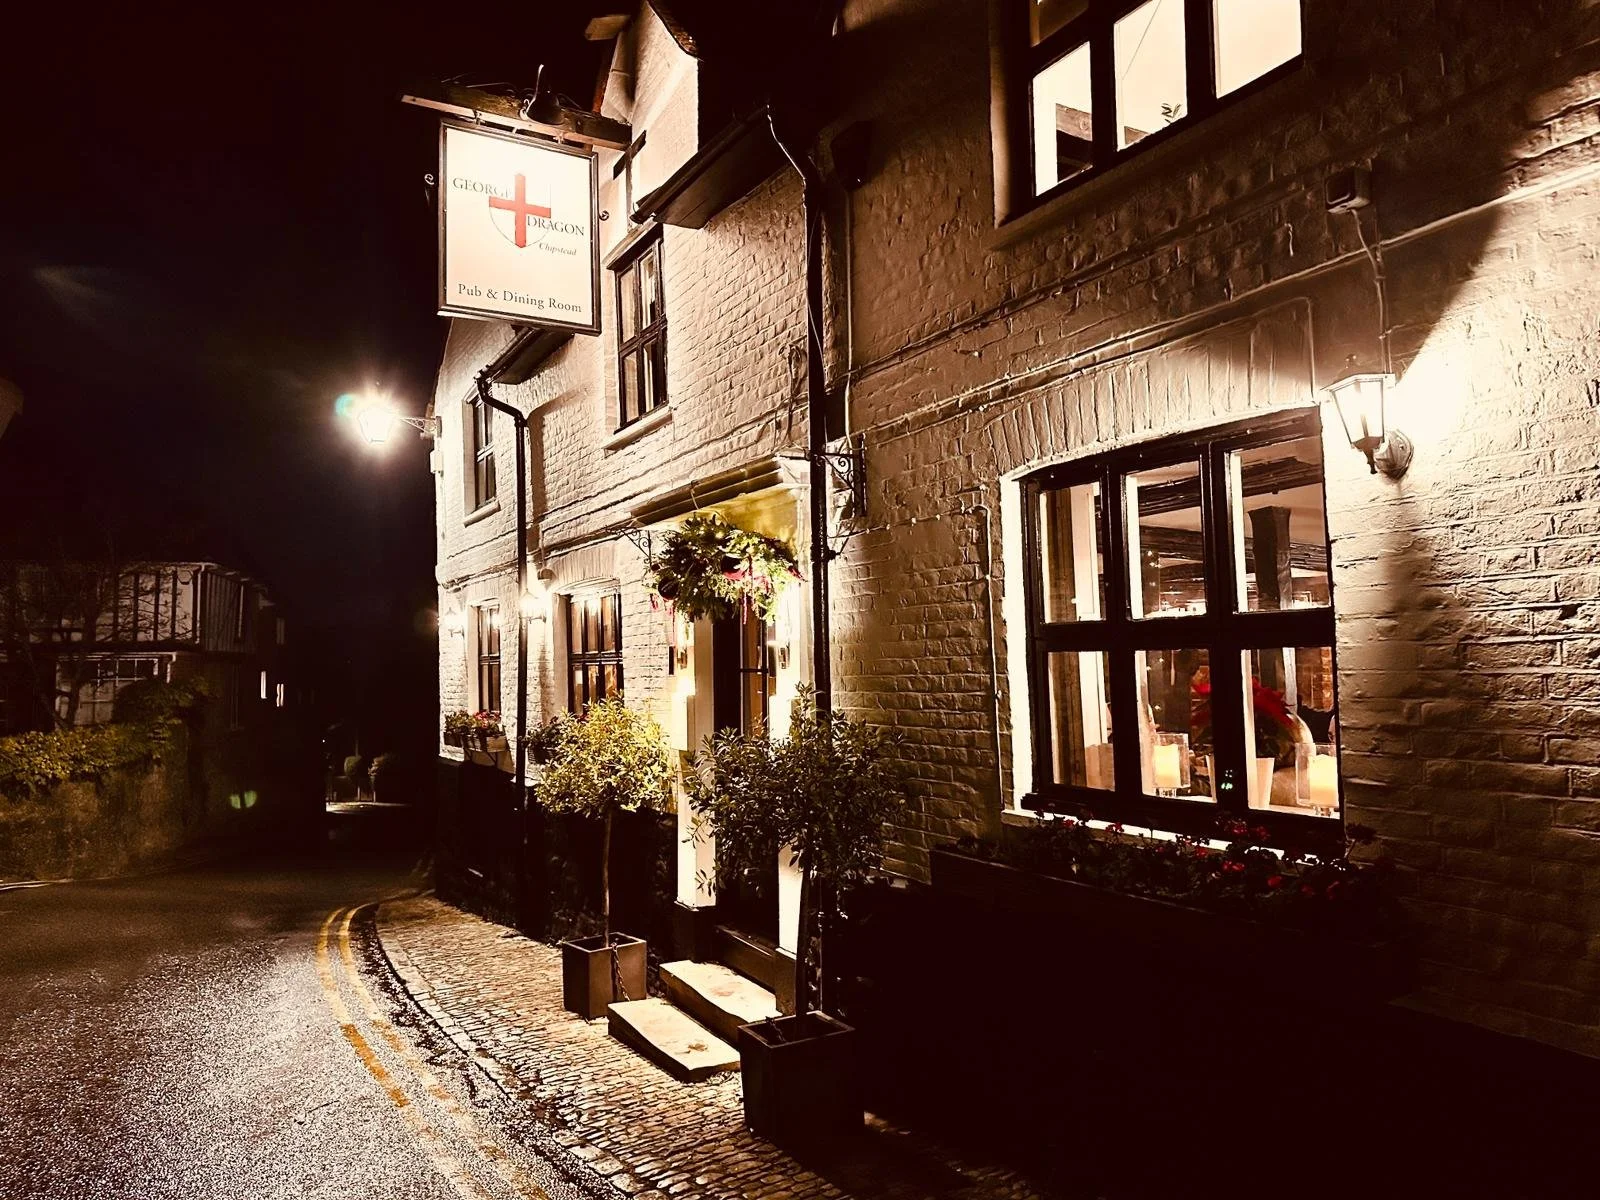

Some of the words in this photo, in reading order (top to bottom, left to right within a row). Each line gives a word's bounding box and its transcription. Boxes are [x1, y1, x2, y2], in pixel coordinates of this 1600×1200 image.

[527, 215, 585, 236] DRAGON
[538, 242, 577, 256] Chipstead
[458, 283, 482, 297] Pub
[486, 288, 499, 300] &
[503, 290, 545, 309] Dining
[548, 297, 582, 313] Room
